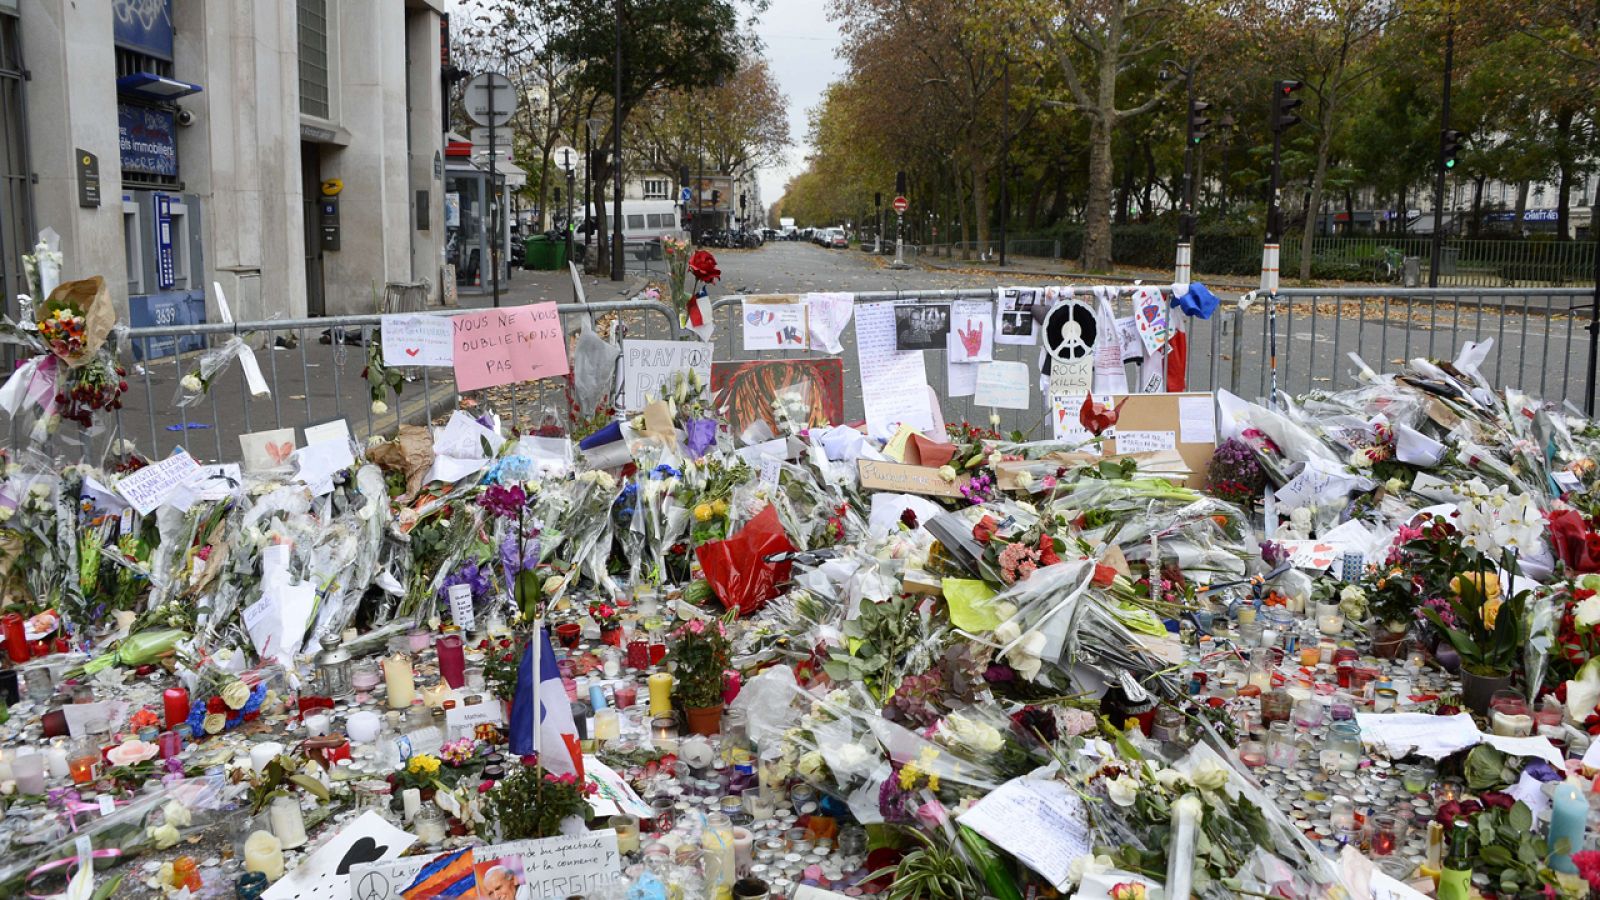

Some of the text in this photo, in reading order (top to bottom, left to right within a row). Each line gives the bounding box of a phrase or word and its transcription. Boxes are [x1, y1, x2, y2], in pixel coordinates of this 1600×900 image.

[120, 137, 131, 150] êts
[155, 308, 176, 324] 3639
[453, 309, 557, 333] NOUS NE VOUS
[463, 328, 557, 351] OUBLIERONS
[629, 347, 675, 367] PRAY
[486, 360, 512, 374] PAS
[1052, 364, 1087, 375] ROCK
[1050, 377, 1087, 387] KILLS
